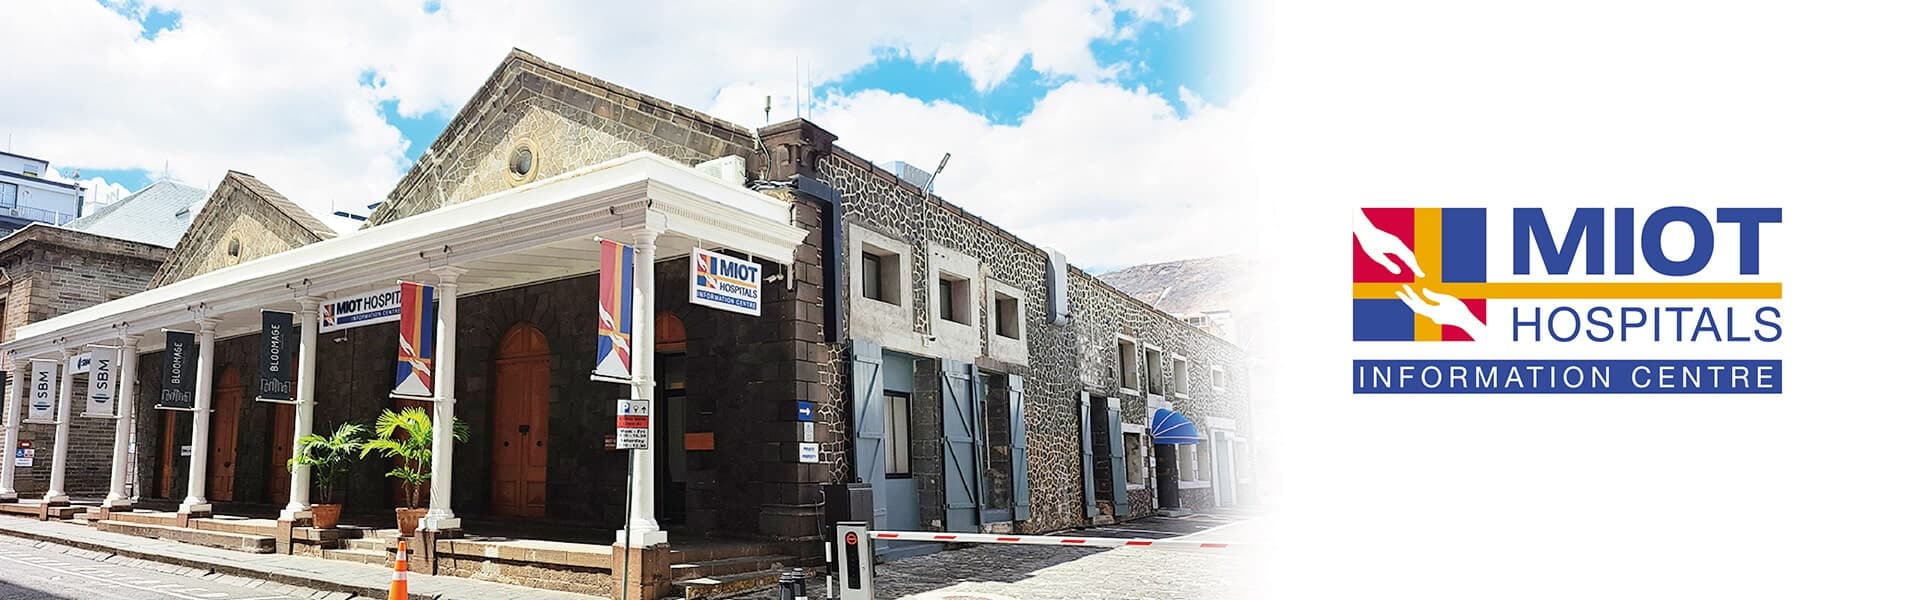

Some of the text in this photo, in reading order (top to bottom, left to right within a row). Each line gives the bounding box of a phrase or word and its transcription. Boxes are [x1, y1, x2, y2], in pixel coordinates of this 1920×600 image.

[720, 259, 758, 283] MIOT
[336, 290, 401, 315] MIOT HOSPIT
[697, 291, 756, 309] INFORMATION CENTRE
[720, 282, 758, 299] HOSPITALS
[269, 323, 281, 372] BLOOMAGE
[96, 359, 110, 390] SBM
[171, 342, 183, 384] BLOOMAGE
[37, 371, 49, 398] SBM
